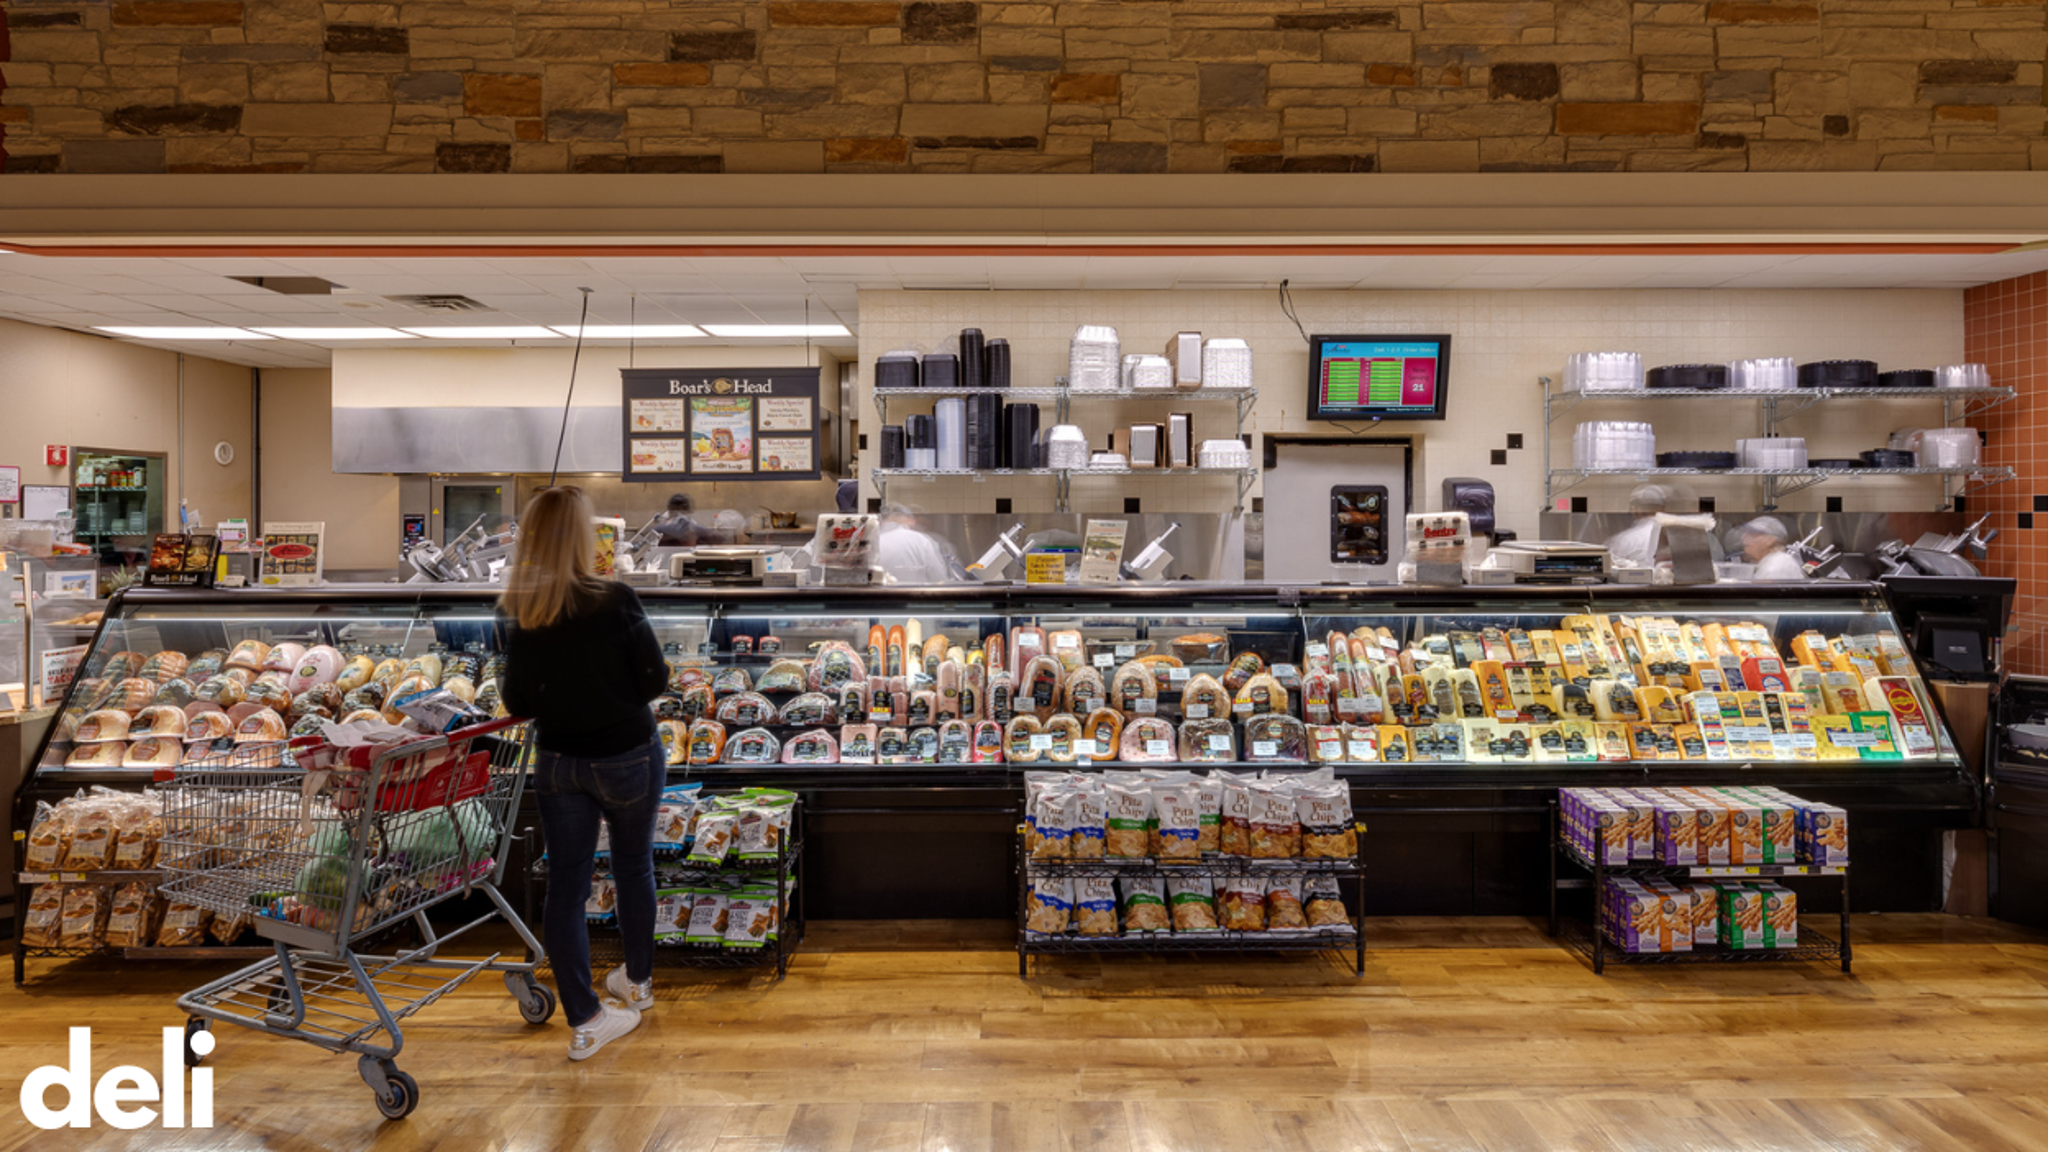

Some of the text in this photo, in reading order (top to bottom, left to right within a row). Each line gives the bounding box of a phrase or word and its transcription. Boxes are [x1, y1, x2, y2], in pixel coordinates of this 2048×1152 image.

[669, 378, 772, 395] Boar's Head
[1412, 383, 1425, 392] 21
[1424, 526, 1457, 539] Sentry
[1121, 795, 1143, 807] Pita
[1200, 792, 1214, 801] ita
[1081, 802, 1100, 815] Pita
[1118, 805, 1145, 818] Chips
[1172, 806, 1194, 816] Pita
[1200, 803, 1217, 813] hips
[1267, 799, 1288, 812] Pita
[1312, 801, 1333, 812] Pita
[1171, 816, 1197, 828] Chips
[1264, 810, 1291, 823] Chips
[1310, 811, 1336, 823] Chips
[1084, 887, 1111, 899] Chips
